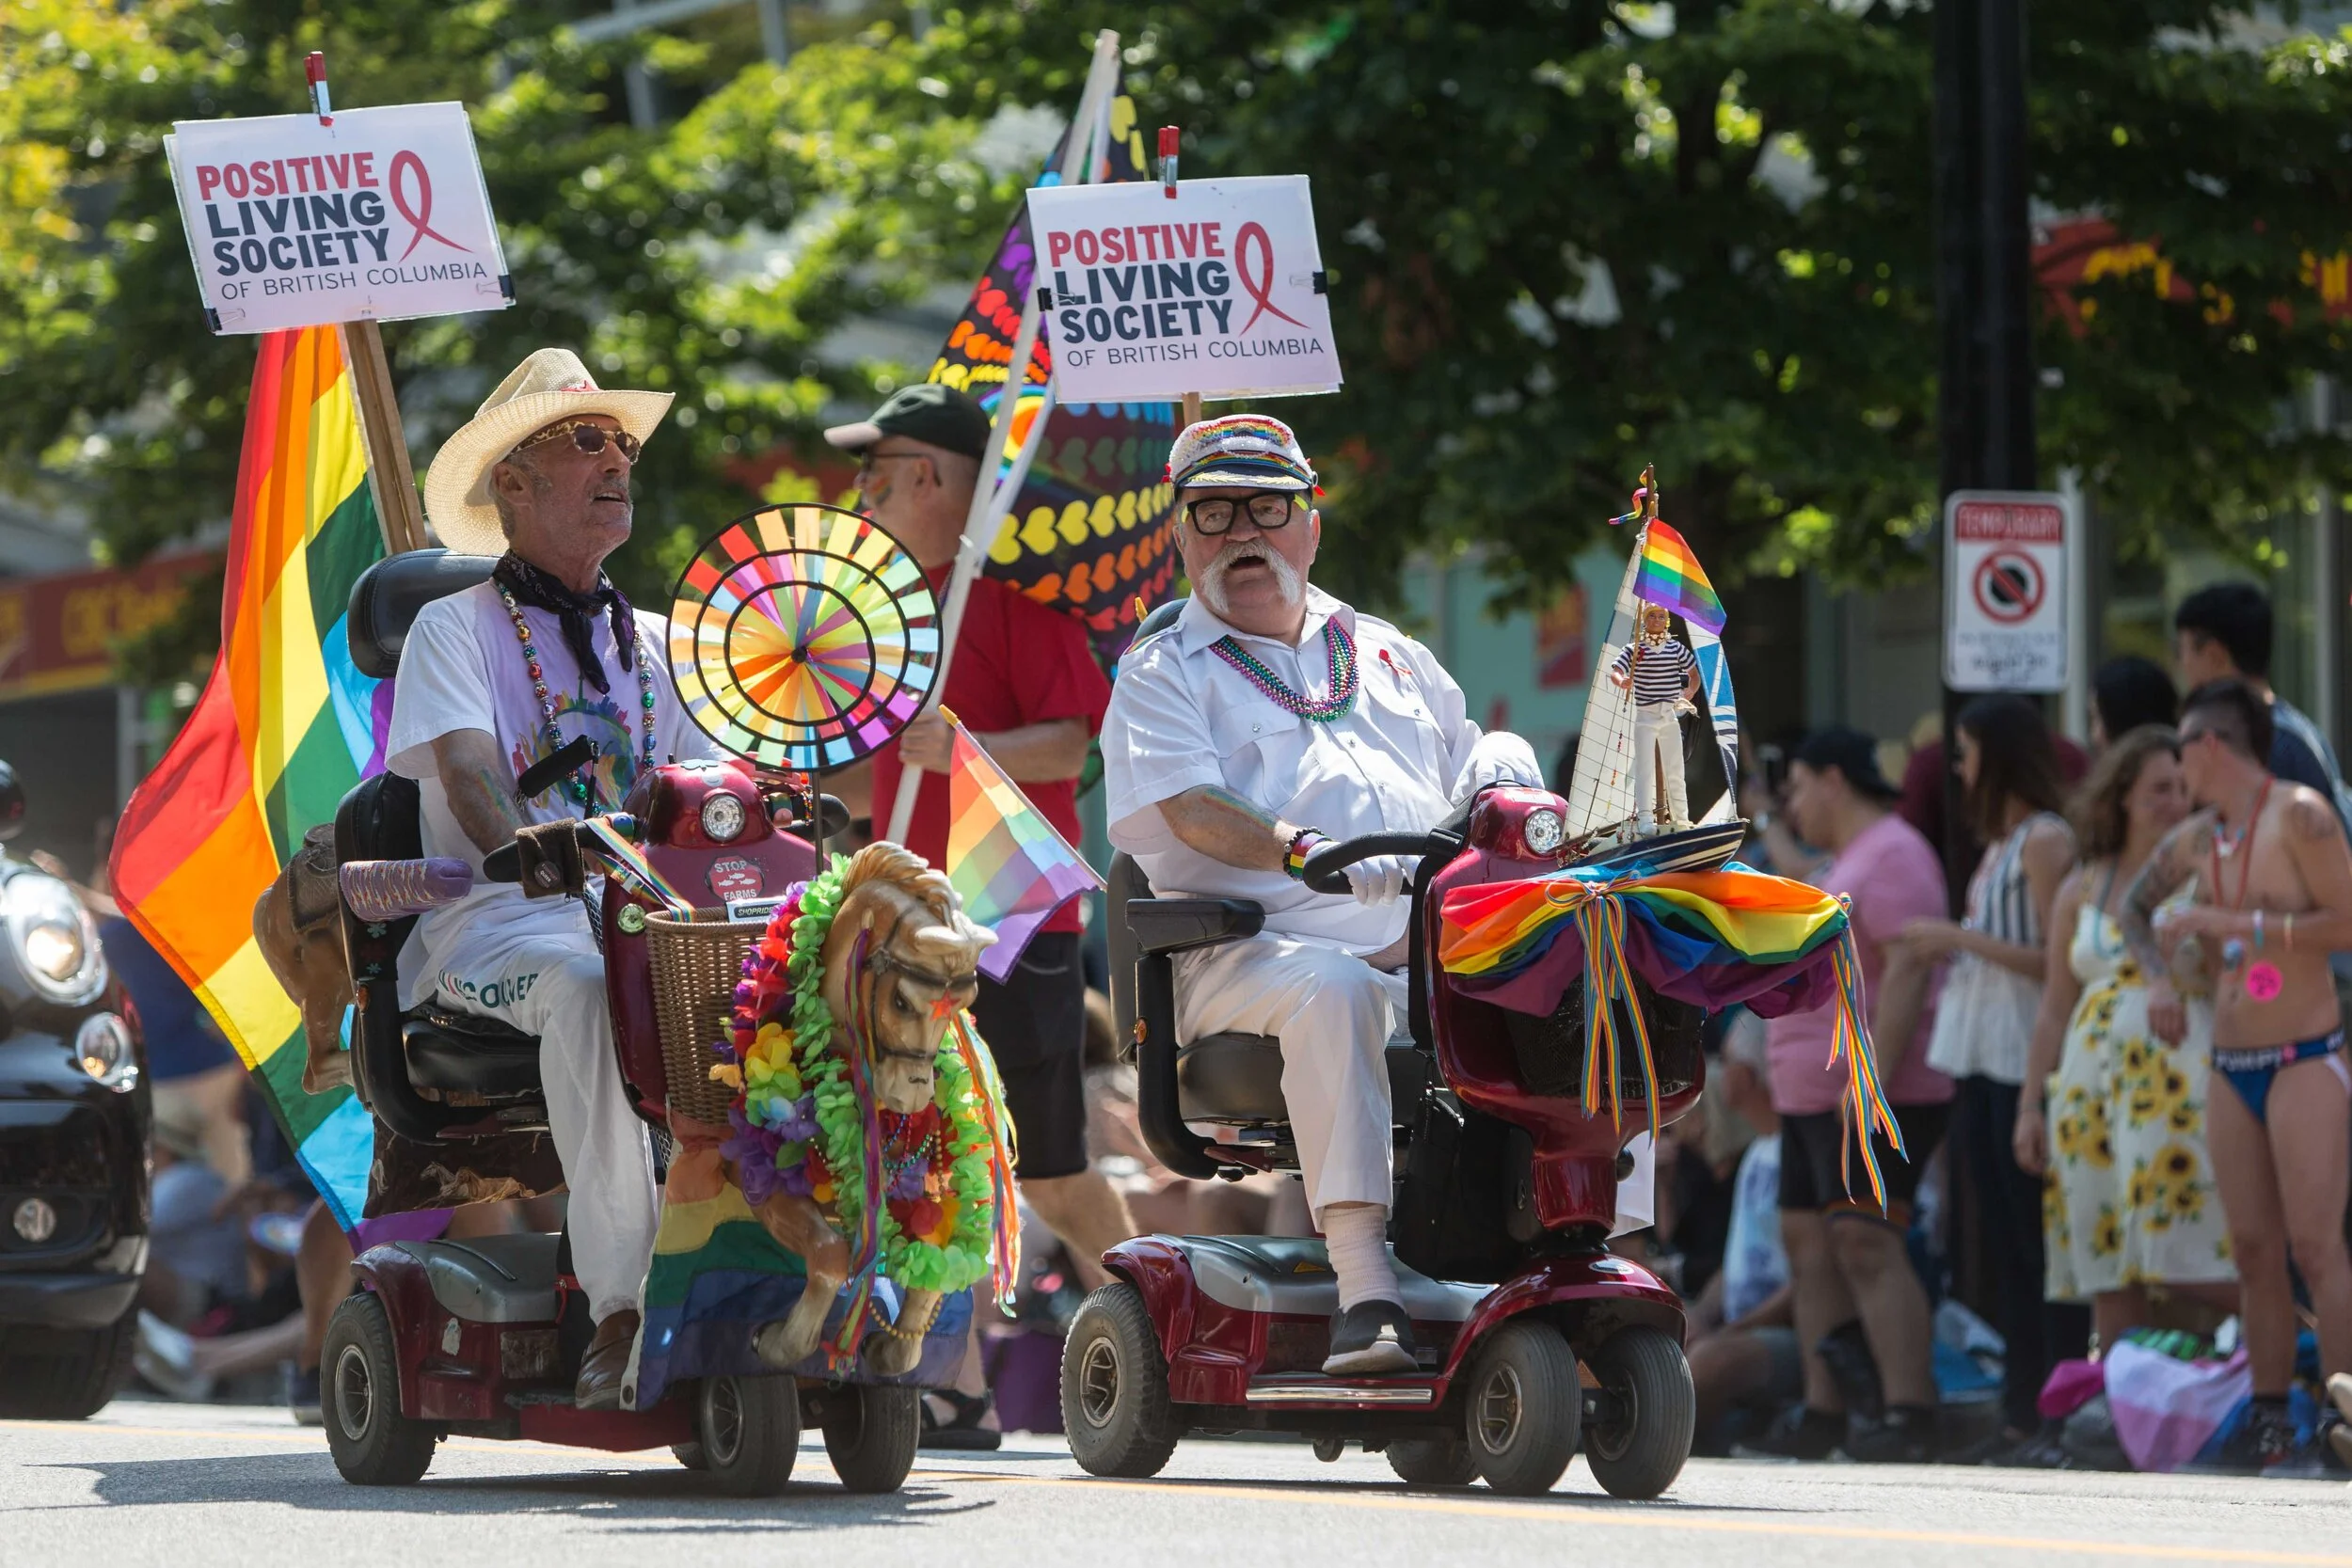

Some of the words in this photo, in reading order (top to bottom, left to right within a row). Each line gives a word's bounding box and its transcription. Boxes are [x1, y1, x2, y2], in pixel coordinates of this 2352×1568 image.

[196, 151, 379, 200] POSITIVE
[204, 191, 386, 239] LIVING
[213, 228, 389, 277] SOCIETY
[1047, 222, 1225, 268] POSITIVE
[221, 281, 251, 300] OF
[264, 271, 357, 296] BRITISH
[367, 261, 487, 286] COLUMBIA
[1055, 261, 1231, 307] LIVING
[1060, 299, 1232, 344] SOCIETY
[1067, 349, 1096, 368] OF
[1108, 343, 1199, 365] BRITISH
[1208, 338, 1325, 358] COLUMBIA
[715, 860, 747, 873] STOP
[723, 889, 757, 900] FARMS
[738, 906, 773, 915] SHOPRIDE
